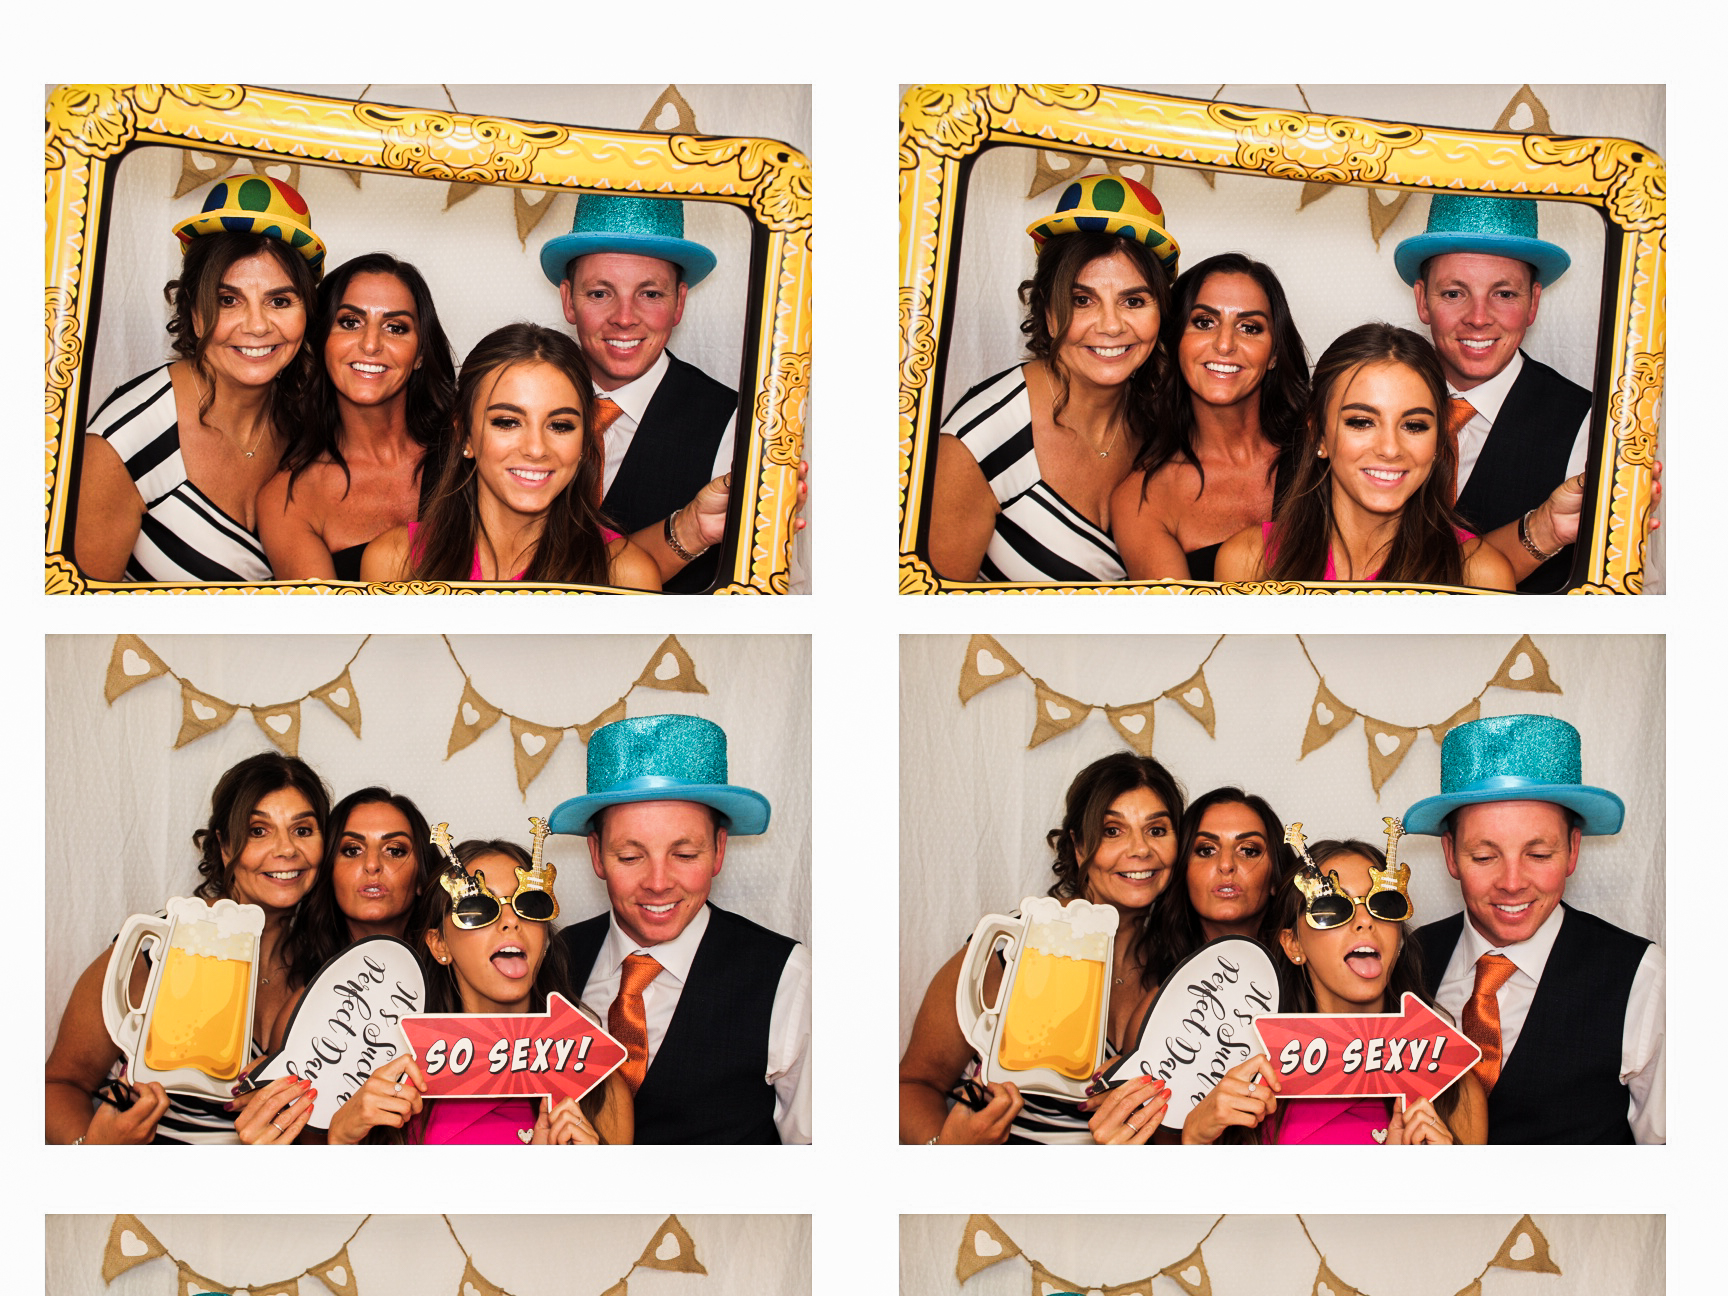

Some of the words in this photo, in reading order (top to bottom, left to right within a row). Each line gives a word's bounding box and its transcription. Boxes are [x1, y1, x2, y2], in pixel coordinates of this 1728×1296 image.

[328, 955, 386, 1037] Perfect
[380, 981, 418, 1028] Its
[1182, 955, 1240, 1037] Perfect
[1234, 981, 1272, 1028] Its
[286, 1036, 348, 1084] Day
[425, 1037, 474, 1075] SO
[488, 1036, 594, 1074] SEXY!
[1140, 1036, 1202, 1084] Day
[1279, 1037, 1328, 1075] SO
[1342, 1036, 1448, 1074] SEXY!
